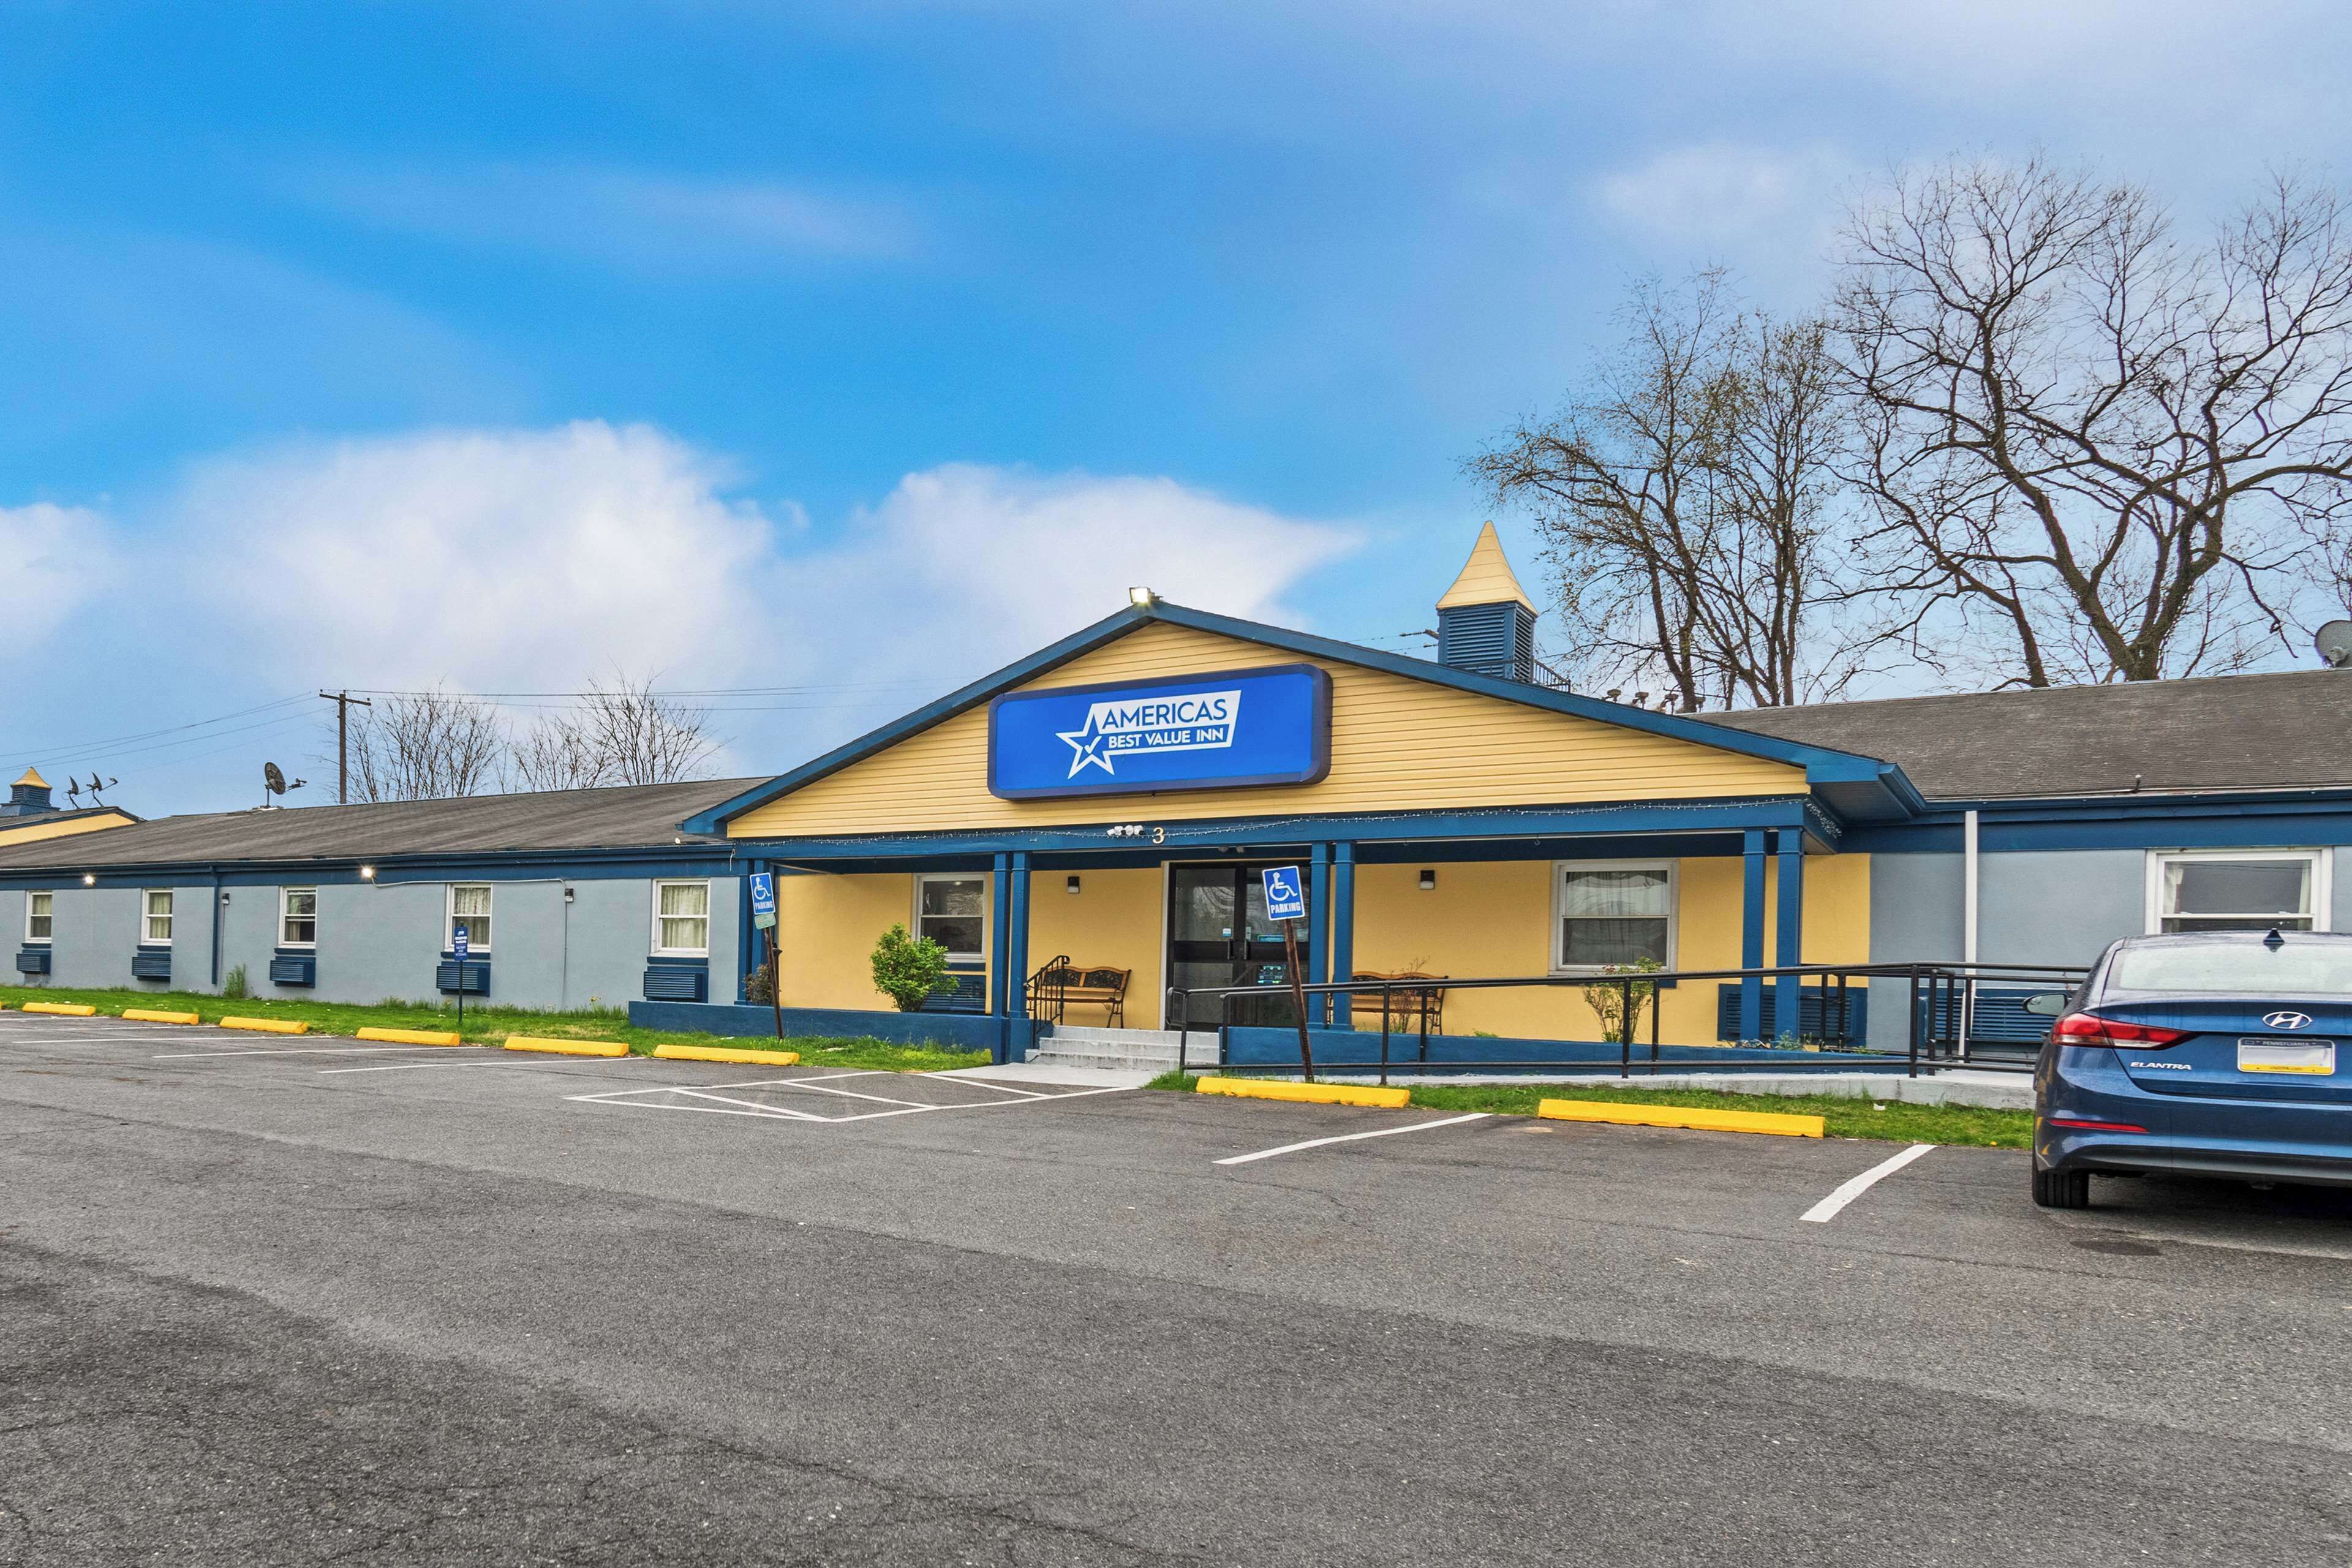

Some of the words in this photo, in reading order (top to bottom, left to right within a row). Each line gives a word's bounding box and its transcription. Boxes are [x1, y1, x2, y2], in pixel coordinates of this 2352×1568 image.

[1102, 698, 1227, 729] AMERICAS
[1108, 734, 1142, 749] BEST
[1145, 730, 1191, 745] VALUE
[1196, 728, 1224, 742] INN
[1152, 827, 1165, 844] 3
[755, 900, 773, 910] PARKING
[1270, 902, 1302, 914] PARKING
[2130, 1061, 2192, 1071] ELANTRA
